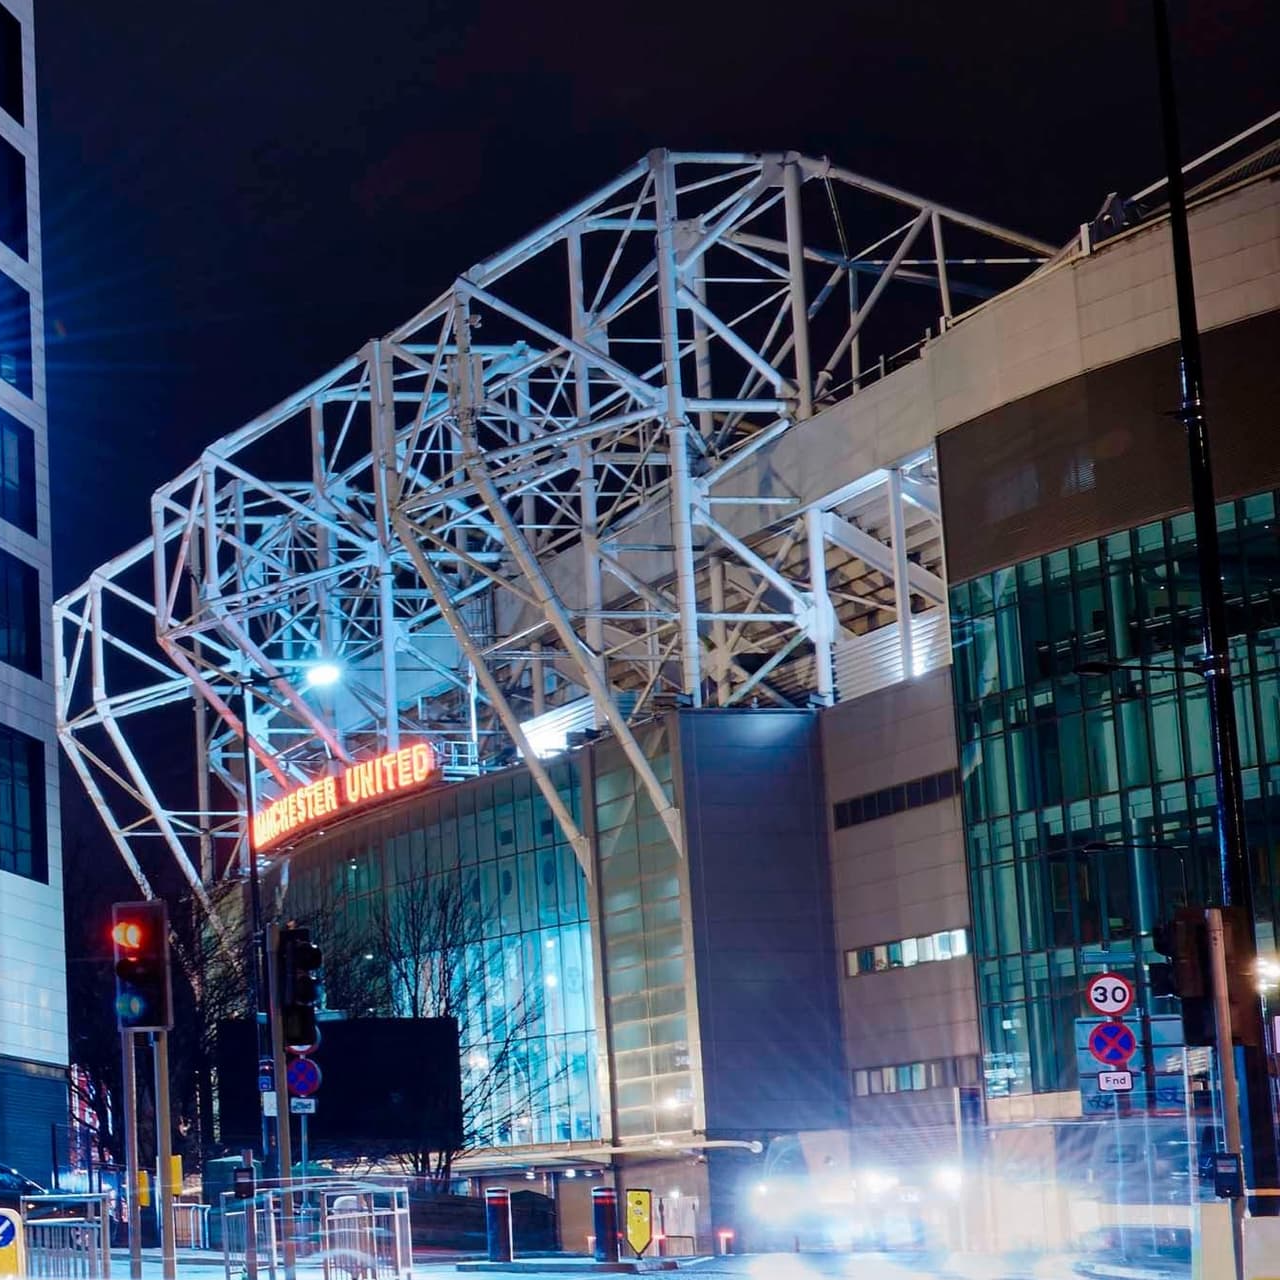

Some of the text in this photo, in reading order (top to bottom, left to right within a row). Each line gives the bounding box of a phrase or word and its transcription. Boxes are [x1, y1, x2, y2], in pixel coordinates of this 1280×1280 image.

[253, 743, 431, 848] MANCHESTER UNITED
[1092, 985, 1127, 1004] 30
